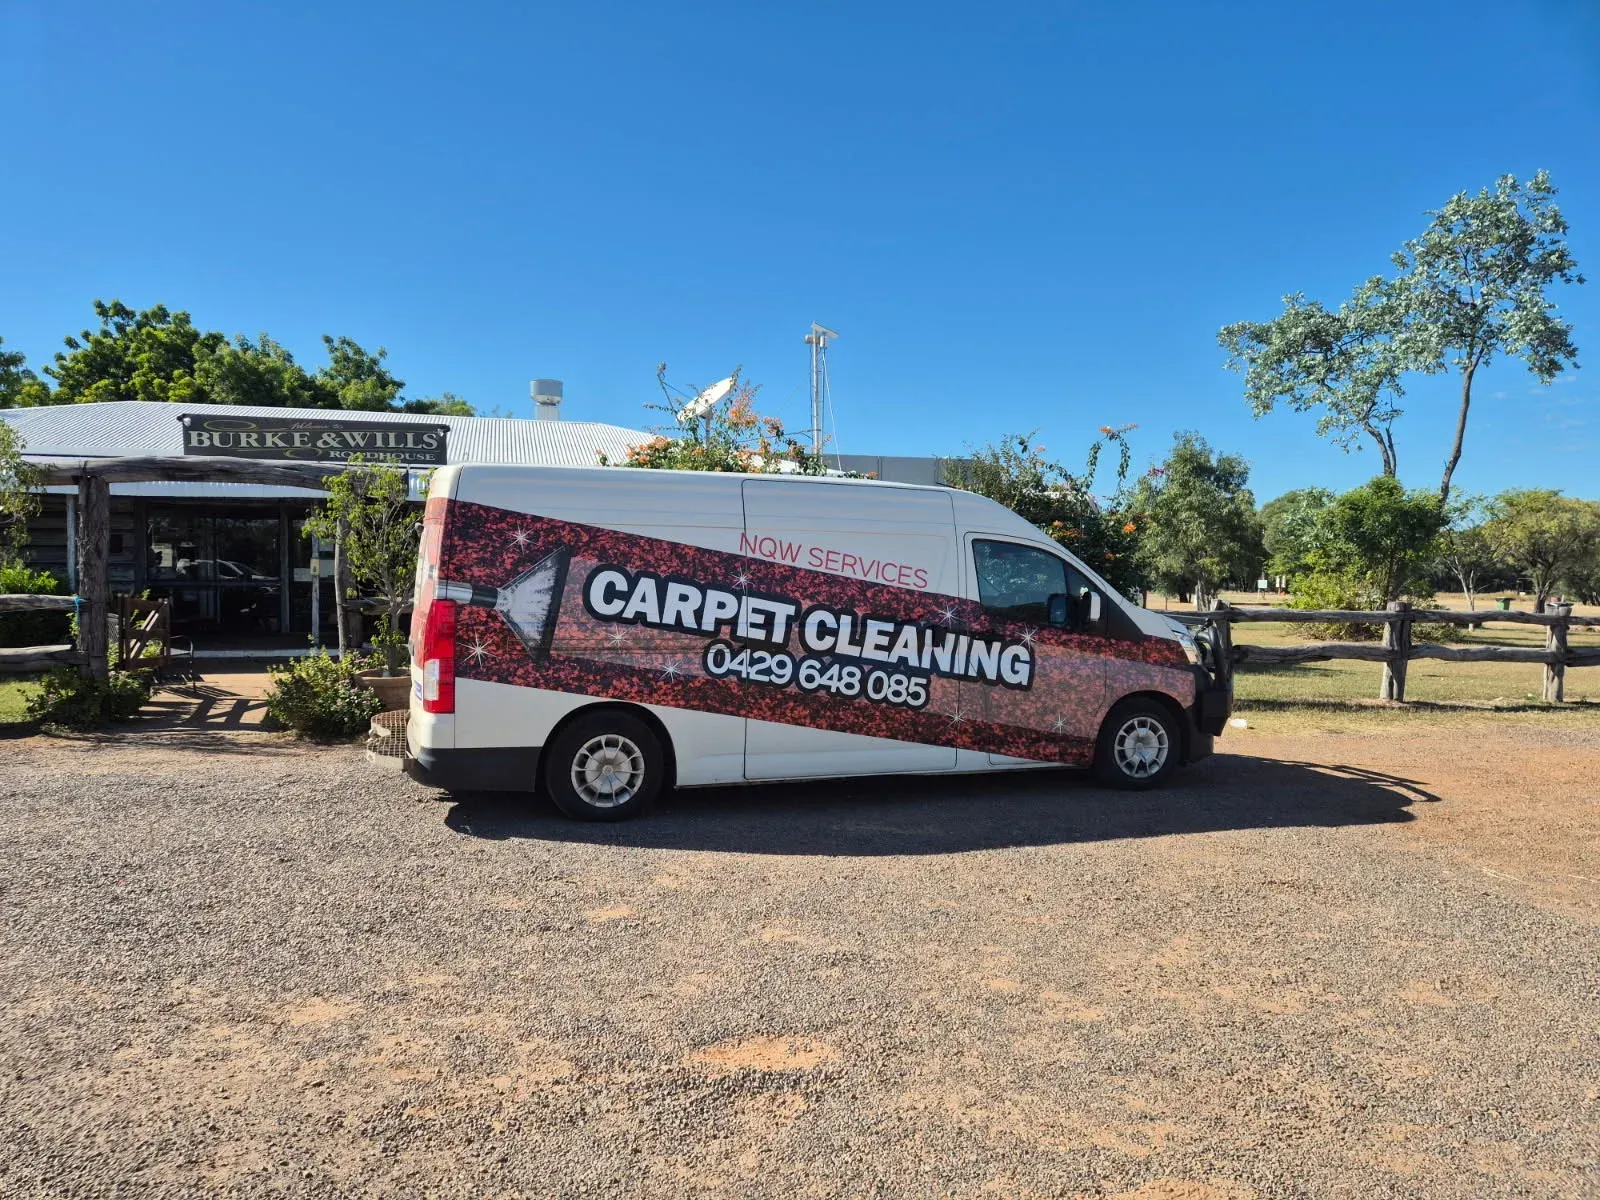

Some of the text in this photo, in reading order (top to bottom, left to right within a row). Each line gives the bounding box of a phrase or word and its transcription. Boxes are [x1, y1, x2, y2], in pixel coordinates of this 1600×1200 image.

[188, 431, 311, 448] BURKE
[340, 432, 438, 449] WILLS
[329, 450, 436, 461] RODHOUSE
[739, 533, 928, 588] NQW SERVICES
[589, 571, 1031, 686] CARPET CLEANING
[707, 643, 927, 707] 0429 648 085
